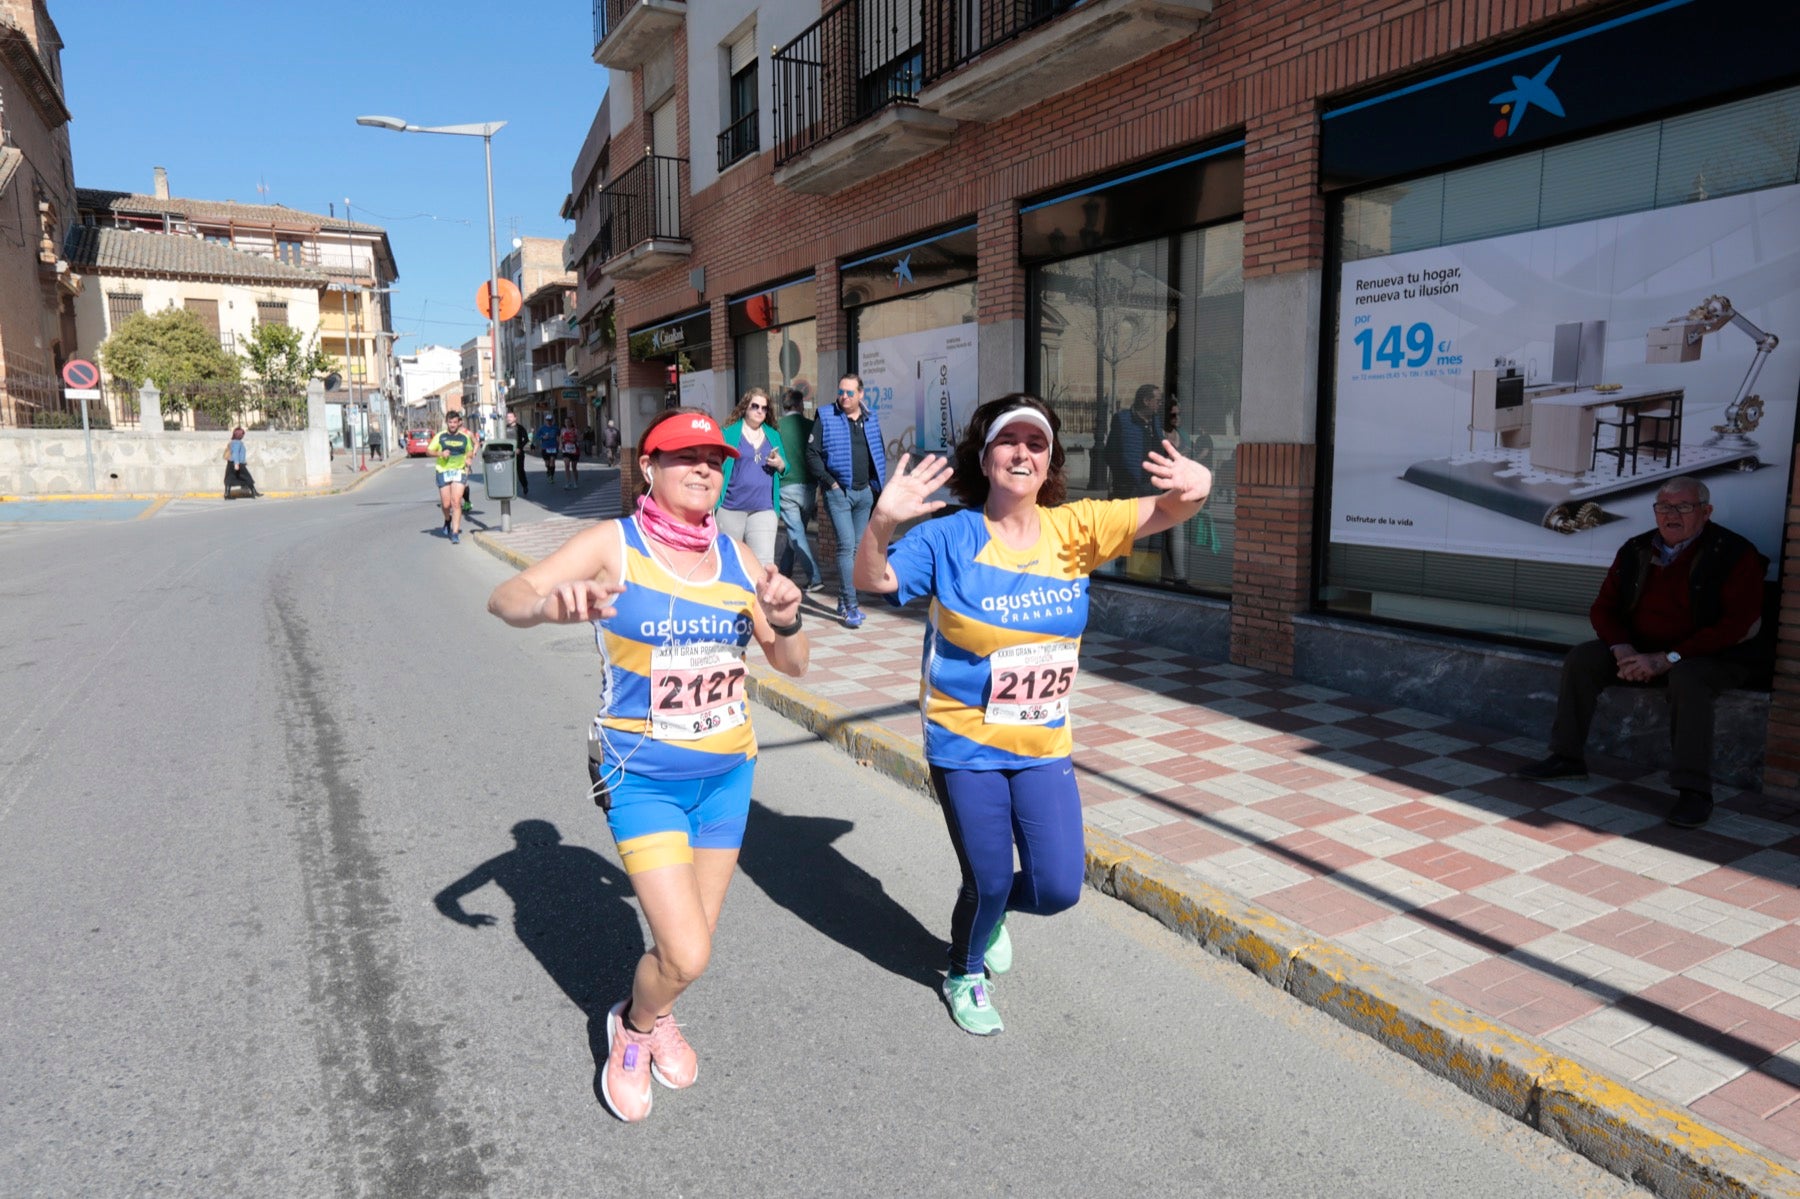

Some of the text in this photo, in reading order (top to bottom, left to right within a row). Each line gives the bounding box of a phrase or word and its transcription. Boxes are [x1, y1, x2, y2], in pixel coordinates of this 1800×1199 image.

[1356, 267, 1461, 291] Renueva tu hogar,
[1355, 281, 1459, 305] renueva tu ilusión
[1354, 314, 1372, 326] por
[1353, 322, 1434, 371] 149
[1437, 354, 1463, 366] mes
[940, 364, 948, 385] 5G
[691, 418, 712, 433] edp
[1346, 515, 1414, 527] Disfrutar de la vida
[981, 583, 1081, 617] agustinos
[1001, 605, 1073, 624] GRANADA
[640, 614, 753, 640] agustinos
[681, 646, 698, 657] GRAN
[658, 668, 745, 709] 2127
[996, 667, 1073, 700] 2125
